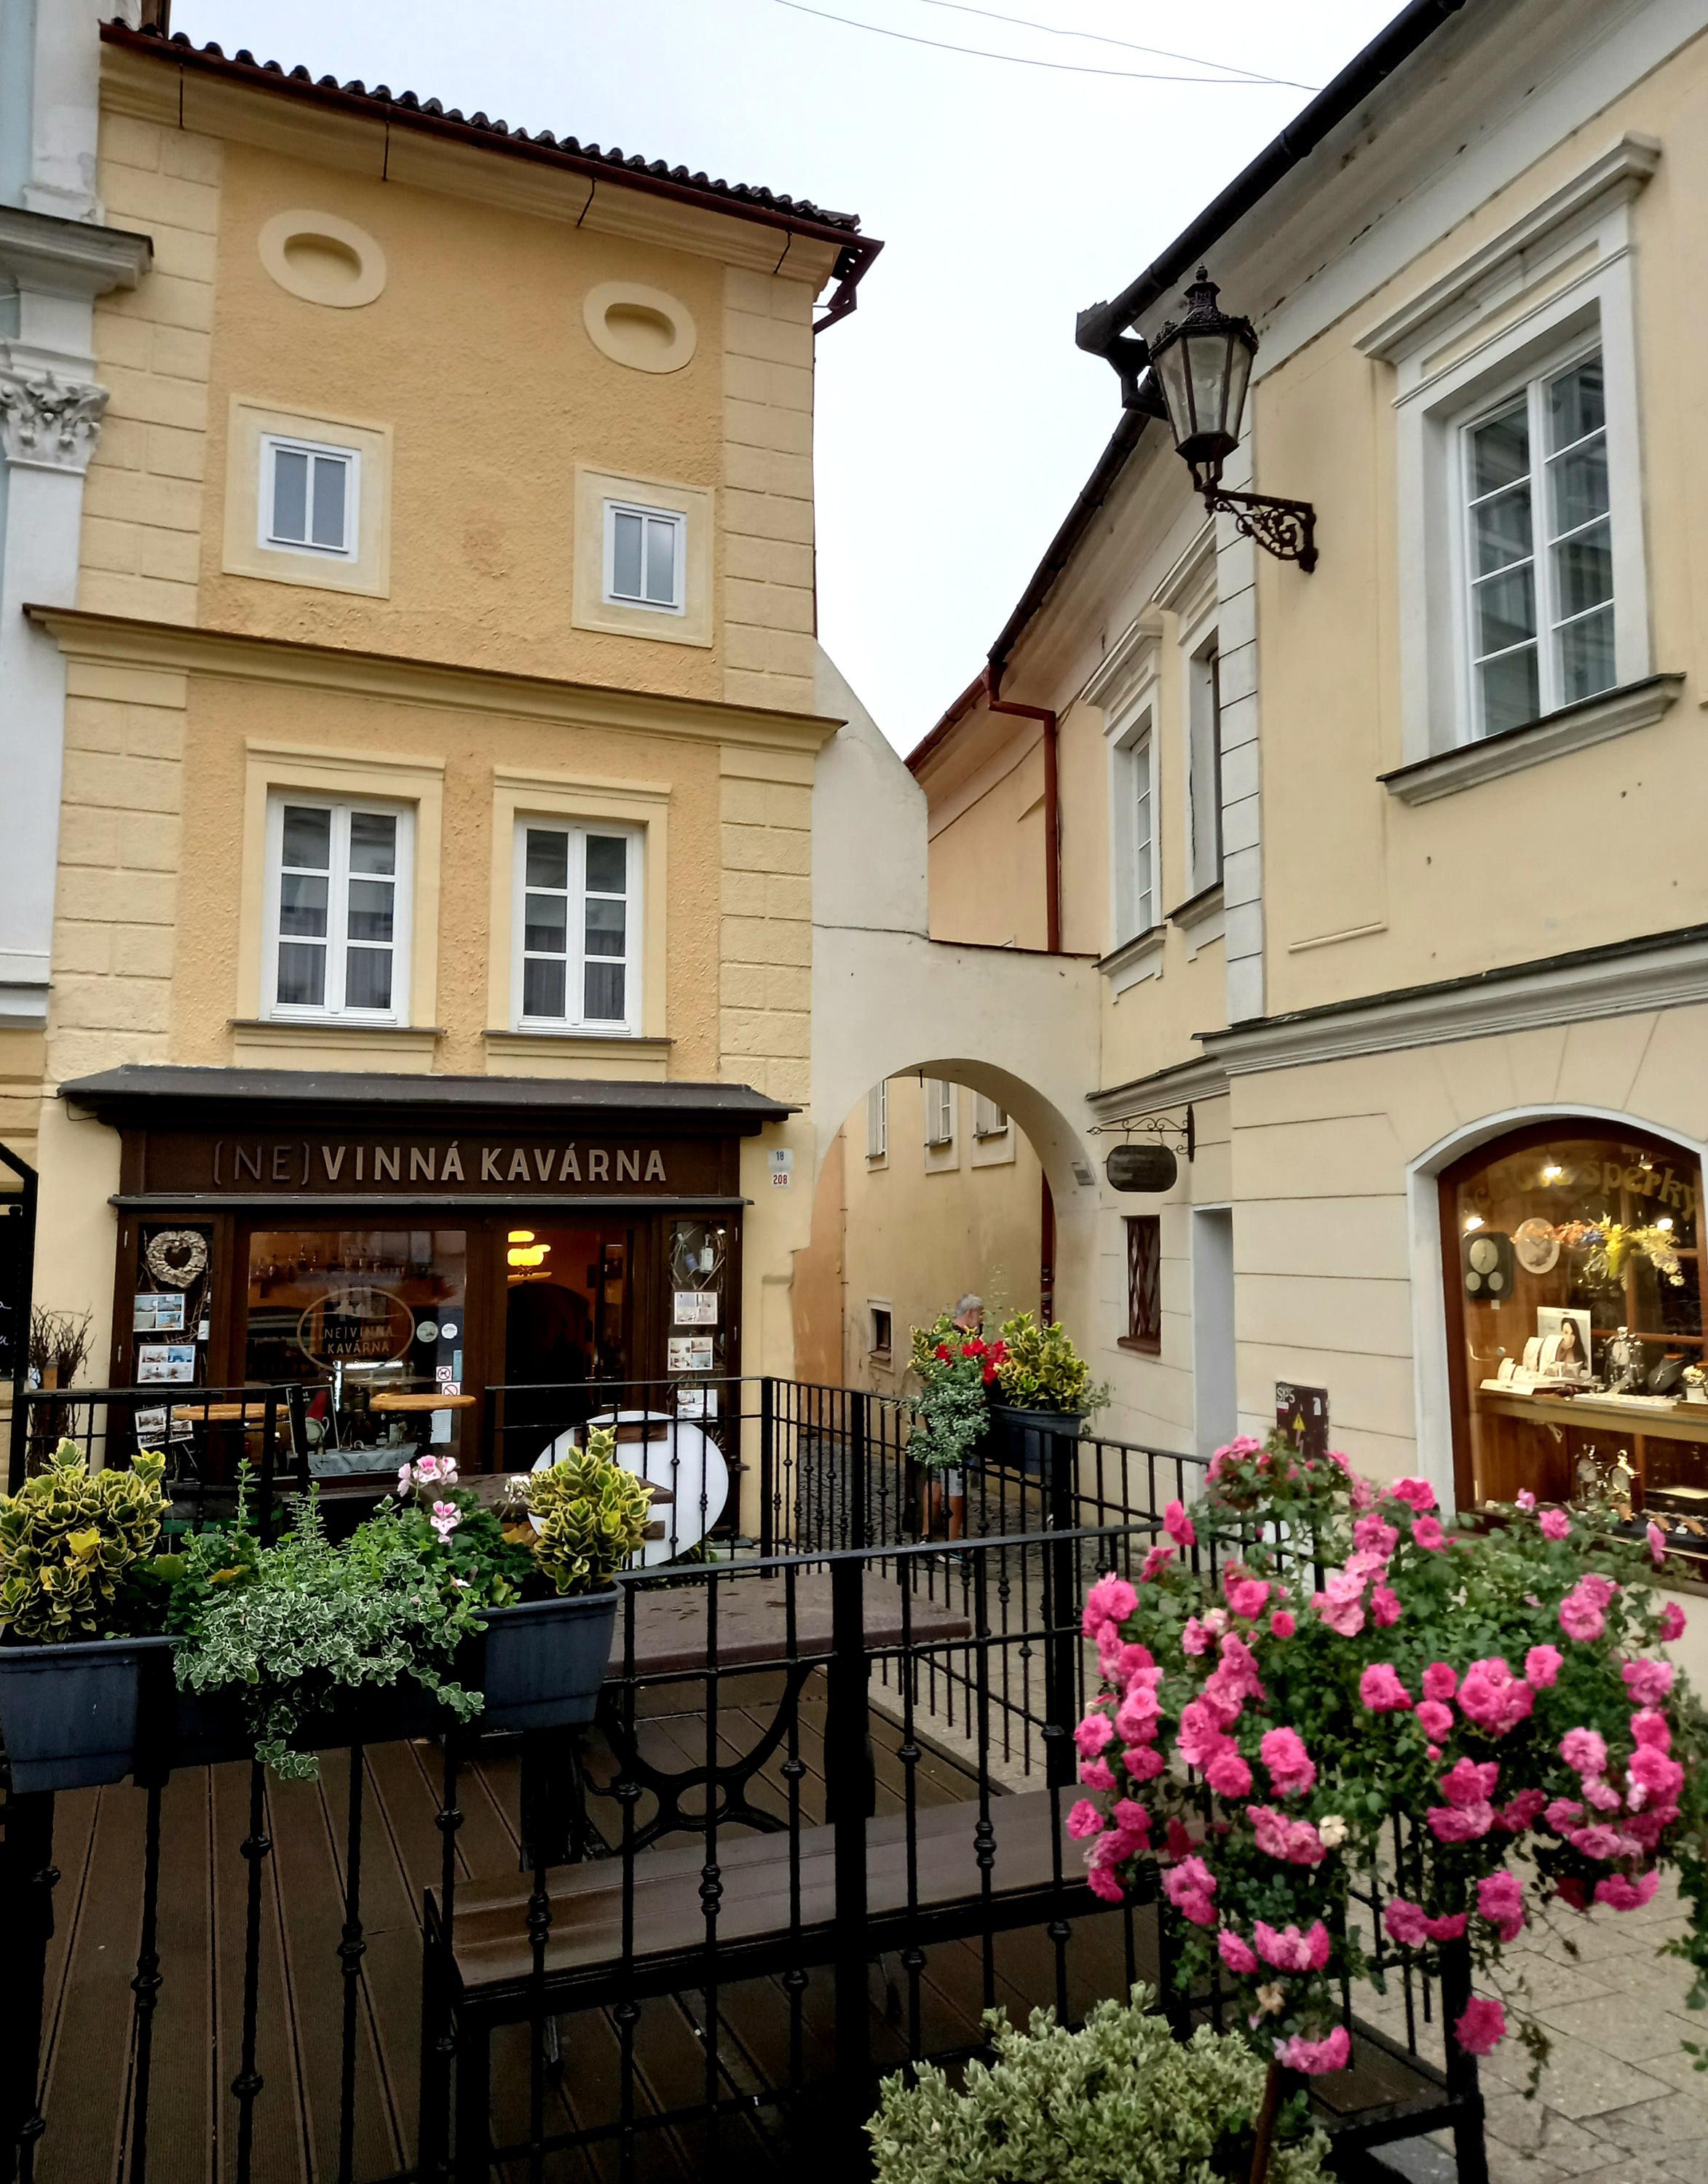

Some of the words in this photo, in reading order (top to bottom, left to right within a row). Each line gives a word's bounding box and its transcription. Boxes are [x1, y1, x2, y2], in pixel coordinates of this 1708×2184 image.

[481, 1142, 667, 1182] KAVÁRNA
[776, 1150, 784, 1161] 18
[772, 1174, 788, 1185] 208
[328, 1340, 390, 1355] KAVÁRNA
